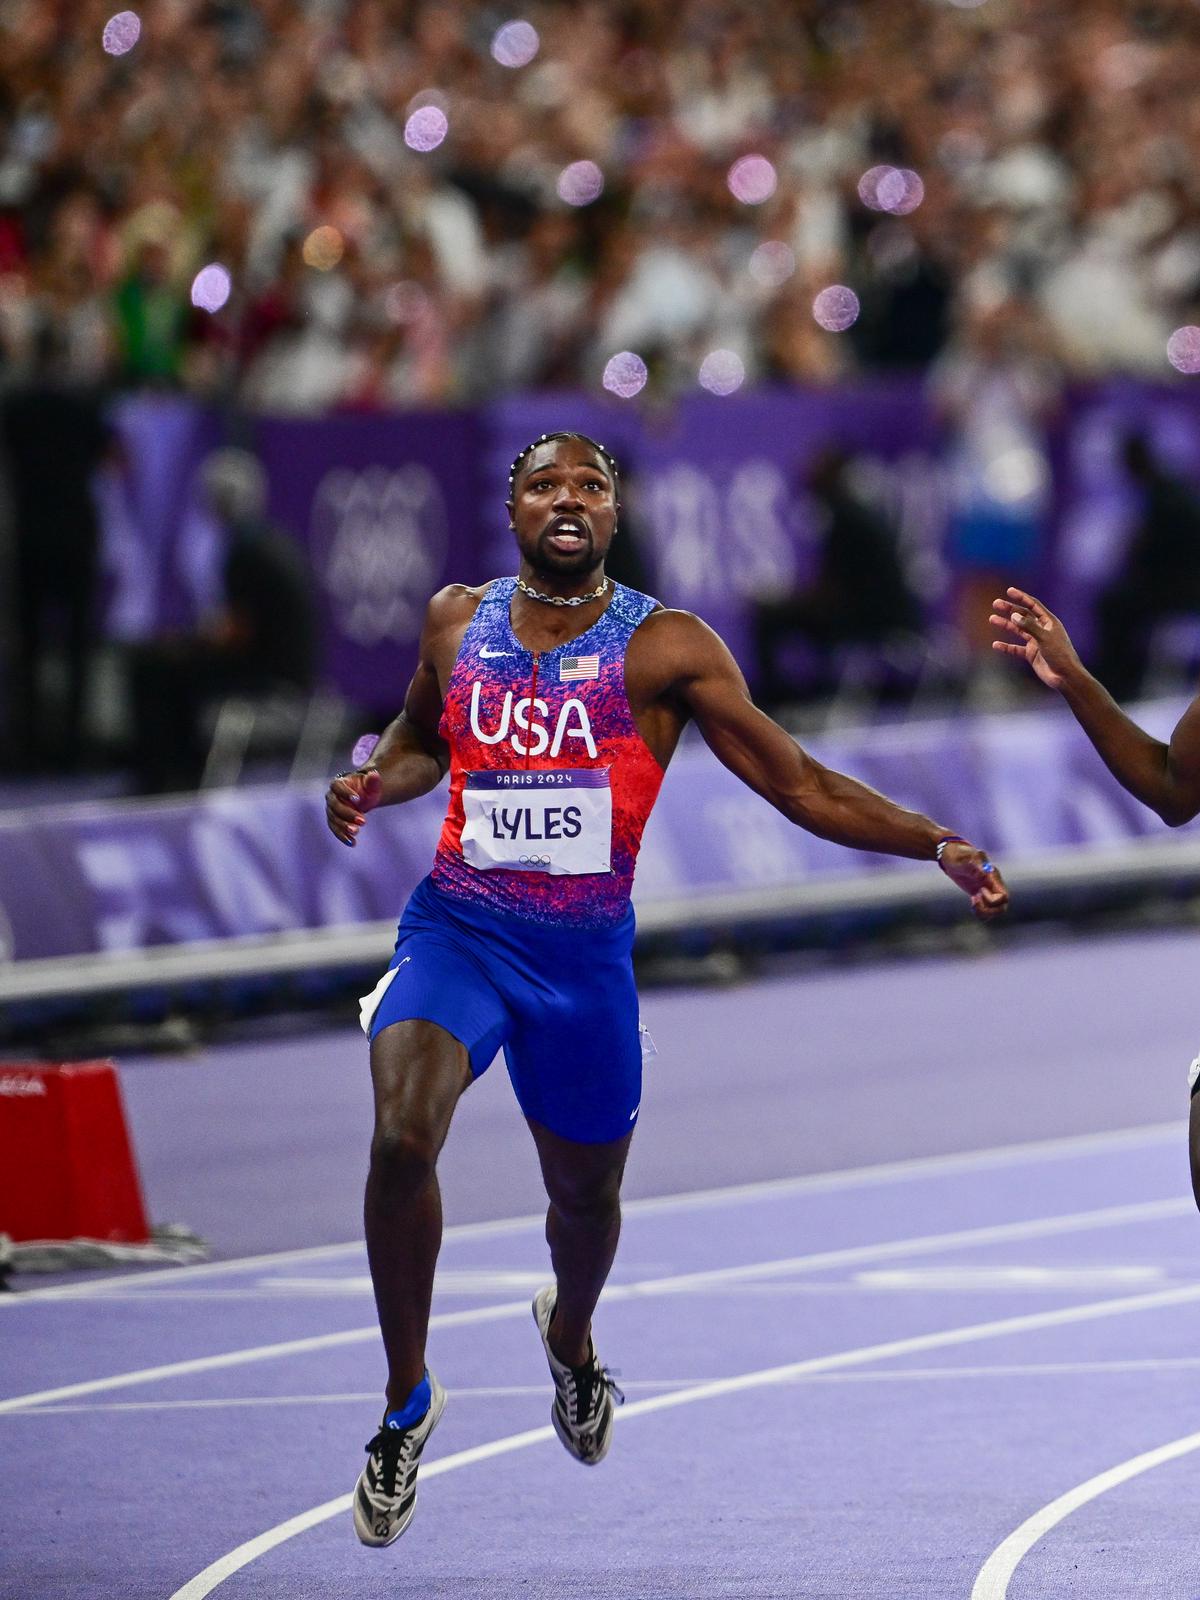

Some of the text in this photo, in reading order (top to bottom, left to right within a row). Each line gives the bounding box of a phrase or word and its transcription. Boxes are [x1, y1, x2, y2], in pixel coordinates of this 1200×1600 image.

[470, 681, 598, 759] USA
[496, 774, 572, 784] PARIS 2024
[491, 806, 582, 840] LYLES
